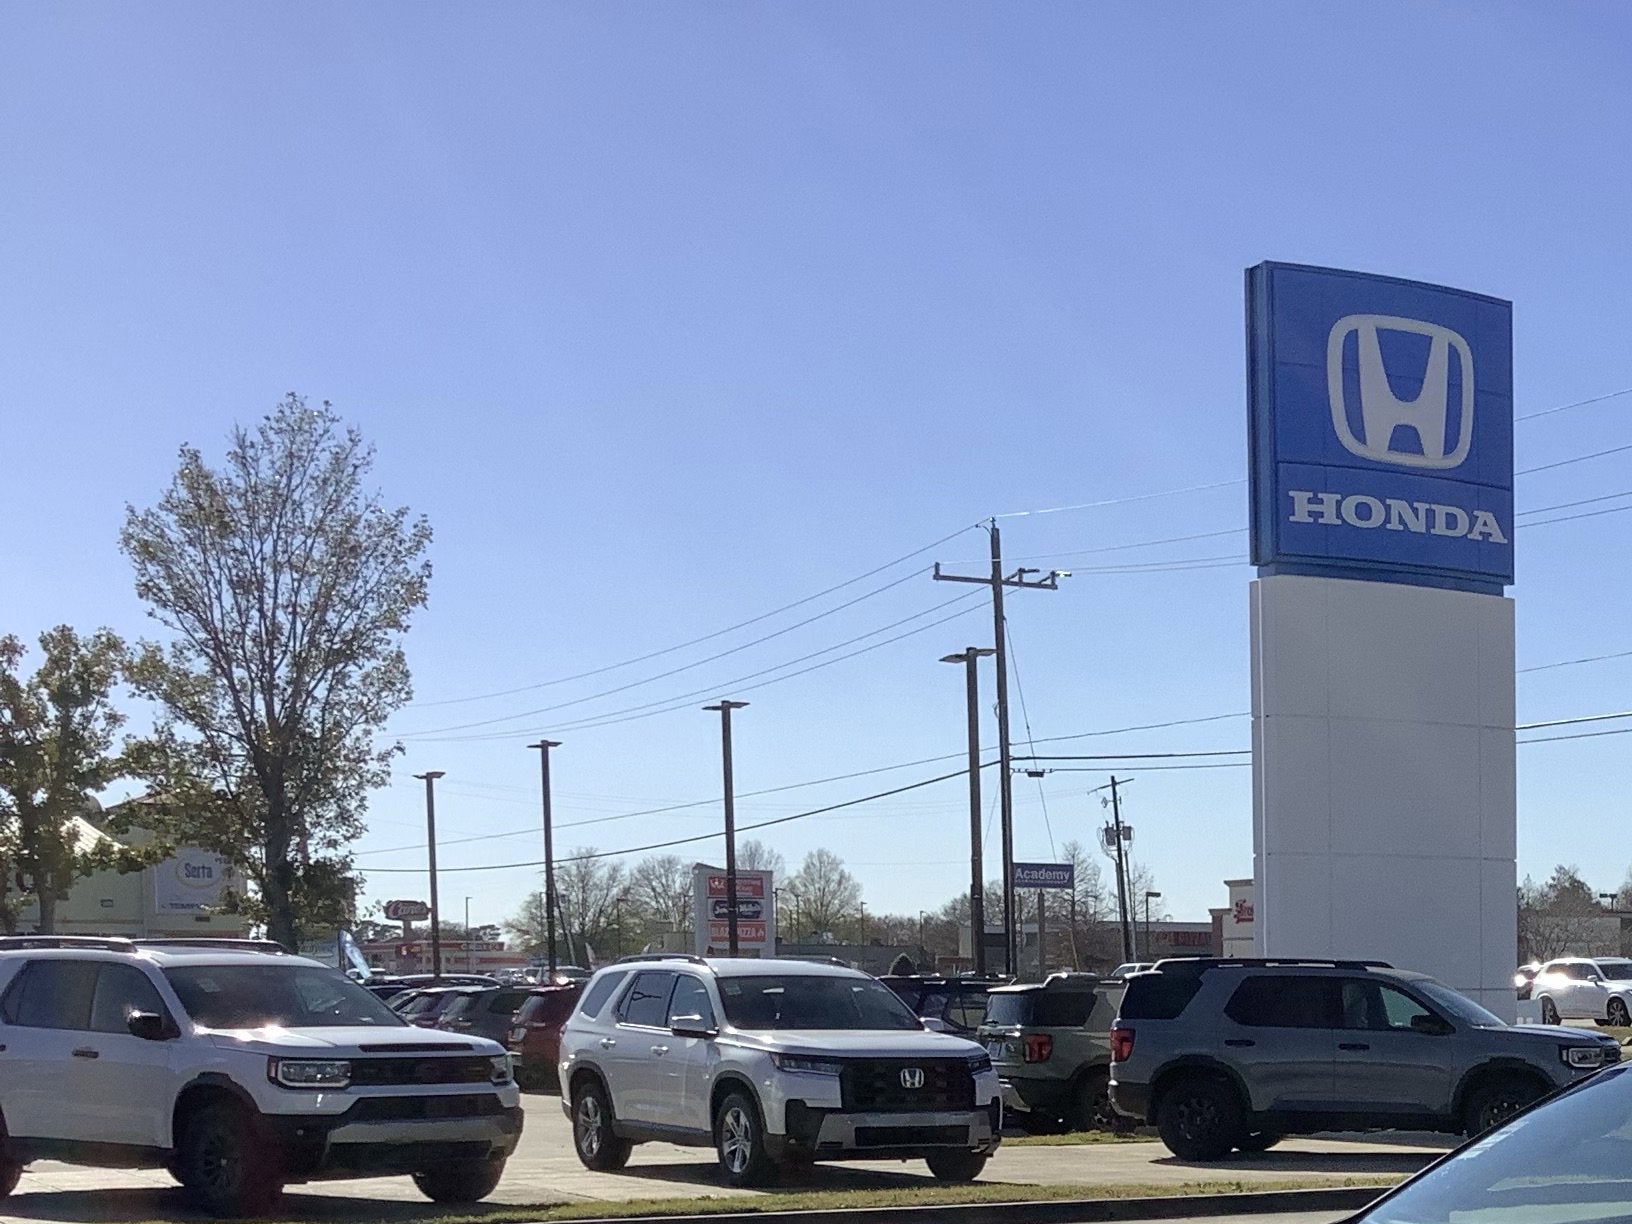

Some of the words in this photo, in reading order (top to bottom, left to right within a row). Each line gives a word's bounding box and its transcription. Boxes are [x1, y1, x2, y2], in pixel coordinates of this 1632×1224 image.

[1288, 490, 1508, 544] HONDA
[184, 863, 213, 879] Serta
[1015, 868, 1070, 883] Academy
